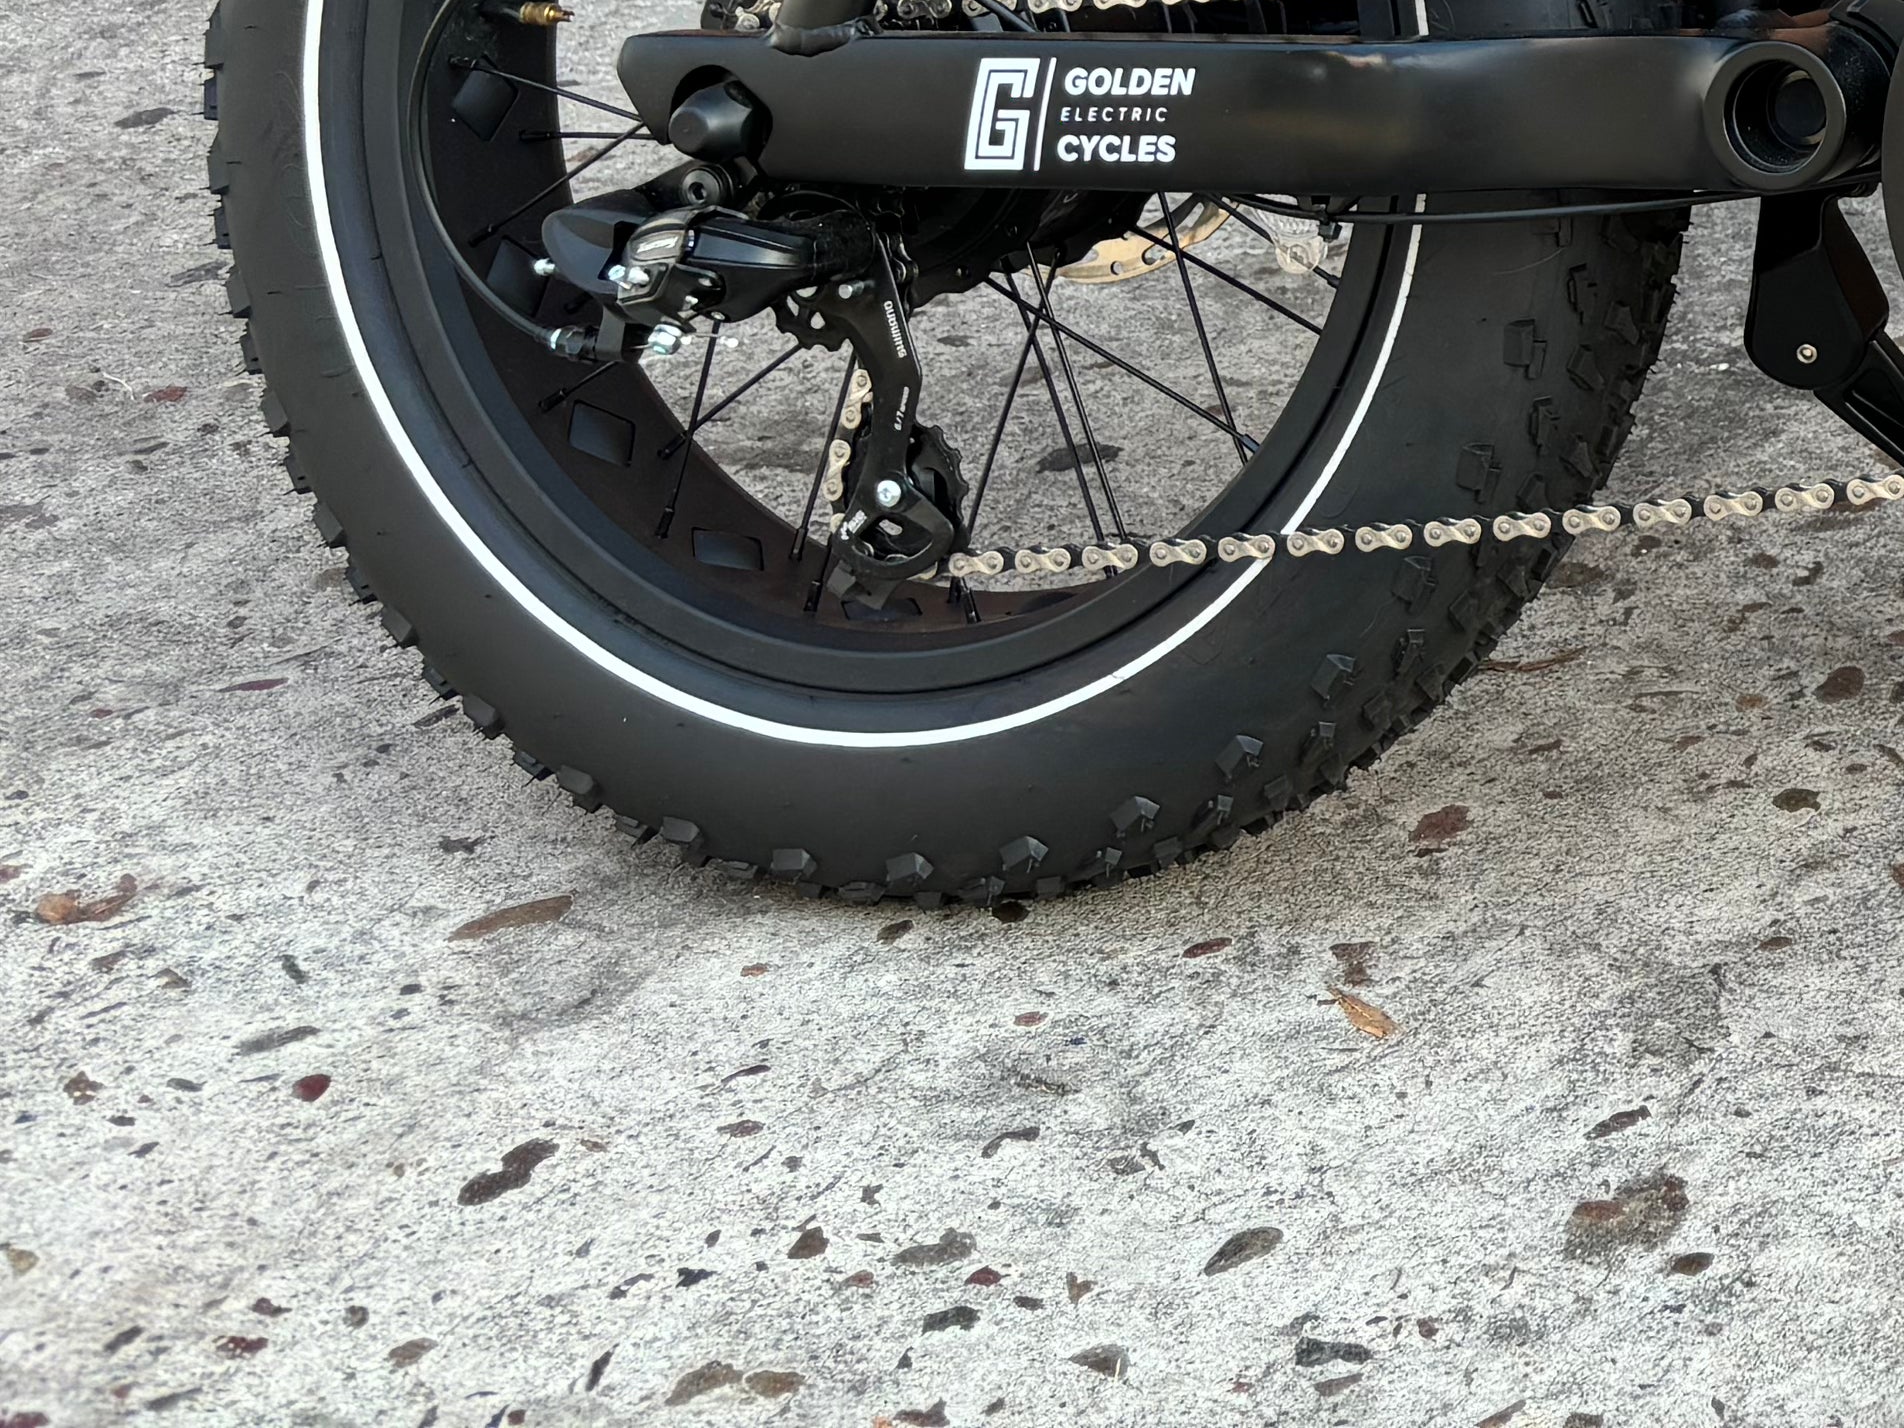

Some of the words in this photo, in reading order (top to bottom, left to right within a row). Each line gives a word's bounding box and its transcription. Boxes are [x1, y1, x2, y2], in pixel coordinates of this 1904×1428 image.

[1063, 65, 1196, 97] GOLDEN
[1059, 106, 1169, 124] ELECTRIC
[1056, 134, 1177, 165] CYCLES
